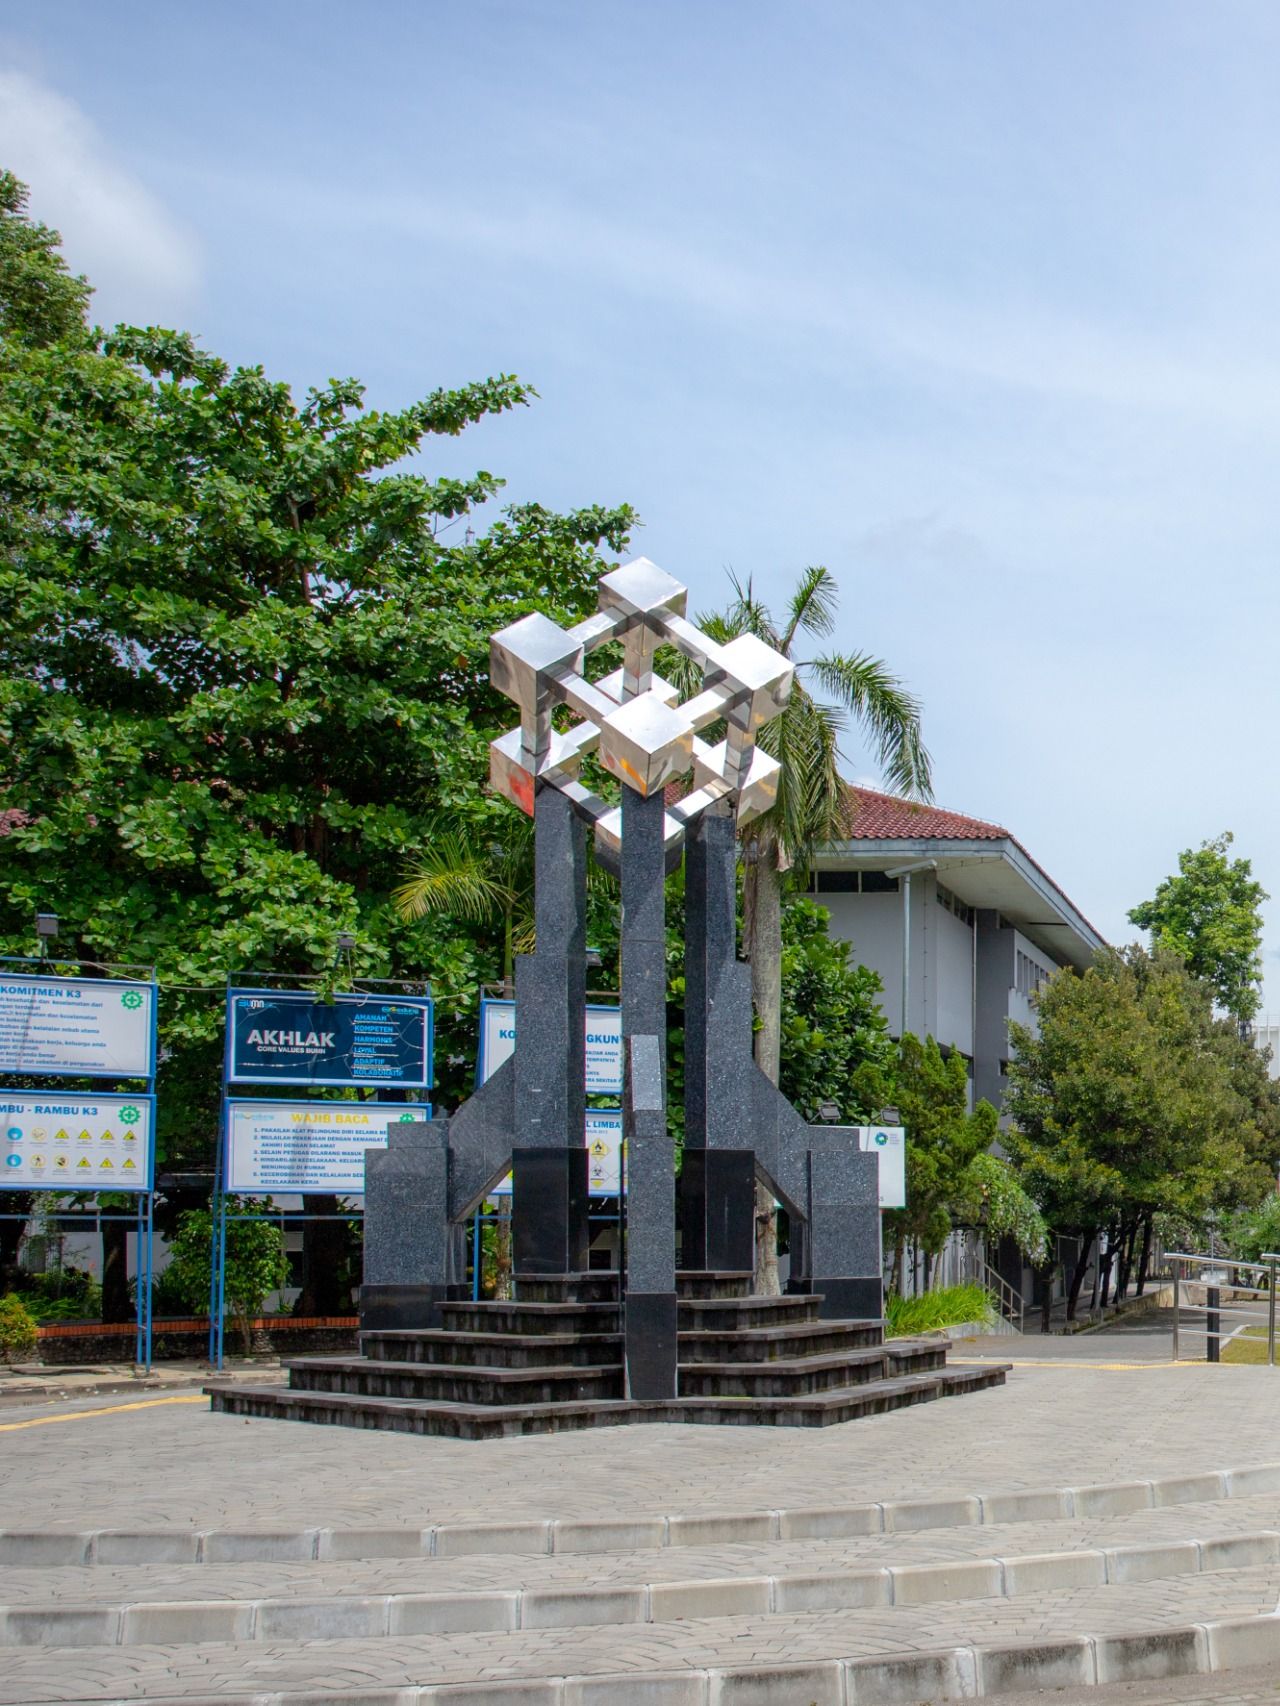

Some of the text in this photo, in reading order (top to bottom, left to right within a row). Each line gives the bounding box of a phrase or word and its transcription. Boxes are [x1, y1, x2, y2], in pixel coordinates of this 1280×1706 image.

[1, 986, 82, 999] KOMITMEN K3
[354, 1025, 393, 1033] KOMPETEN
[247, 1030, 335, 1047] AKHLAK
[354, 1036, 393, 1044] HARMONIS
[586, 1034, 620, 1044] GKUN
[278, 1046, 305, 1054] VALUES
[353, 1058, 385, 1066] ADAPTIF
[34, 1105, 79, 1115] RAMBU
[82, 1107, 98, 1116] K3
[290, 1113, 369, 1125] WAJIB BACA
